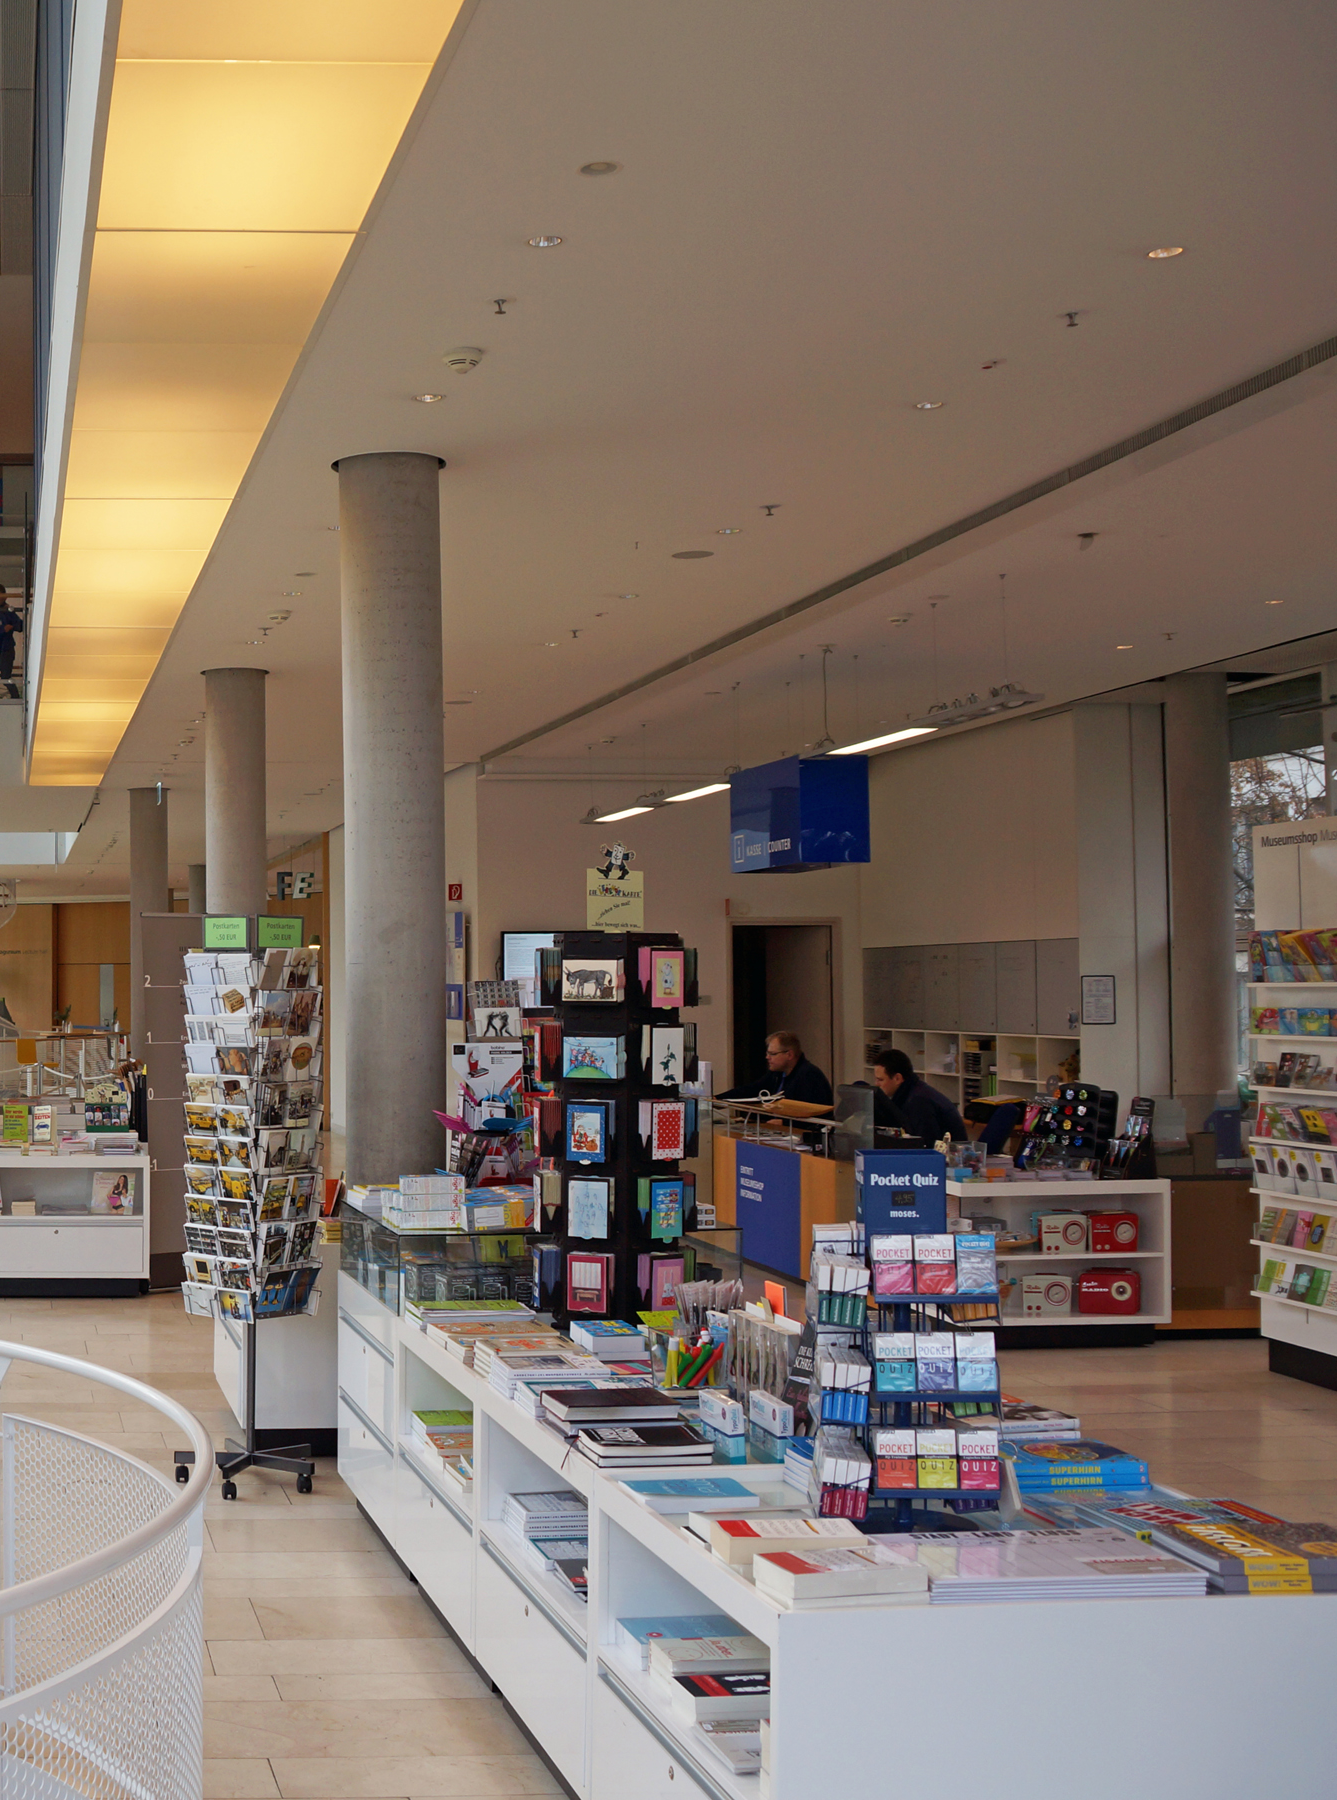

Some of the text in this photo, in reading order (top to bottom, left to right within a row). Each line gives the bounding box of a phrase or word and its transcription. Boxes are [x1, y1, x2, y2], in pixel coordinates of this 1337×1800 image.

[1261, 831, 1318, 847] Museumsshop
[746, 843, 762, 857] KASSE
[767, 838, 792, 853] COUNTER
[266, 871, 315, 900] FE
[212, 922, 240, 930] Postkarten
[266, 922, 295, 930] Postkarten
[144, 975, 152, 987] 2
[147, 1031, 152, 1043] 1
[147, 1087, 154, 1100] 0
[150, 1159, 158, 1171] -1
[870, 1173, 939, 1187] Pocket Quiz
[889, 1210, 920, 1218] moses.
[876, 1248, 910, 1259] POCKET
[918, 1248, 952, 1259] POCKET
[798, 1345, 807, 1356] DIE
[879, 1347, 913, 1357] POCKET
[918, 1346, 952, 1356] POCKET
[959, 1346, 992, 1356] POCKET
[879, 1364, 913, 1374] QUIZ
[919, 1363, 953, 1373] QUIZ
[960, 1366, 994, 1376] QUIZ
[731, 1408, 739, 1432] TypoQuiz
[781, 1410, 789, 1434] TypoQuiz
[879, 1444, 913, 1453] POCKET
[919, 1443, 954, 1453] POCKET
[962, 1444, 996, 1454] POCKET
[880, 1461, 914, 1470] QUIZ
[920, 1460, 955, 1470] QUIZ
[962, 1461, 997, 1472] QUIZ
[1049, 1466, 1101, 1474] SUPERHIRN
[1051, 1477, 1103, 1486] SUPERHIRN
[1248, 1563, 1278, 1571] WOW!
[1252, 1580, 1281, 1588] WOW!
